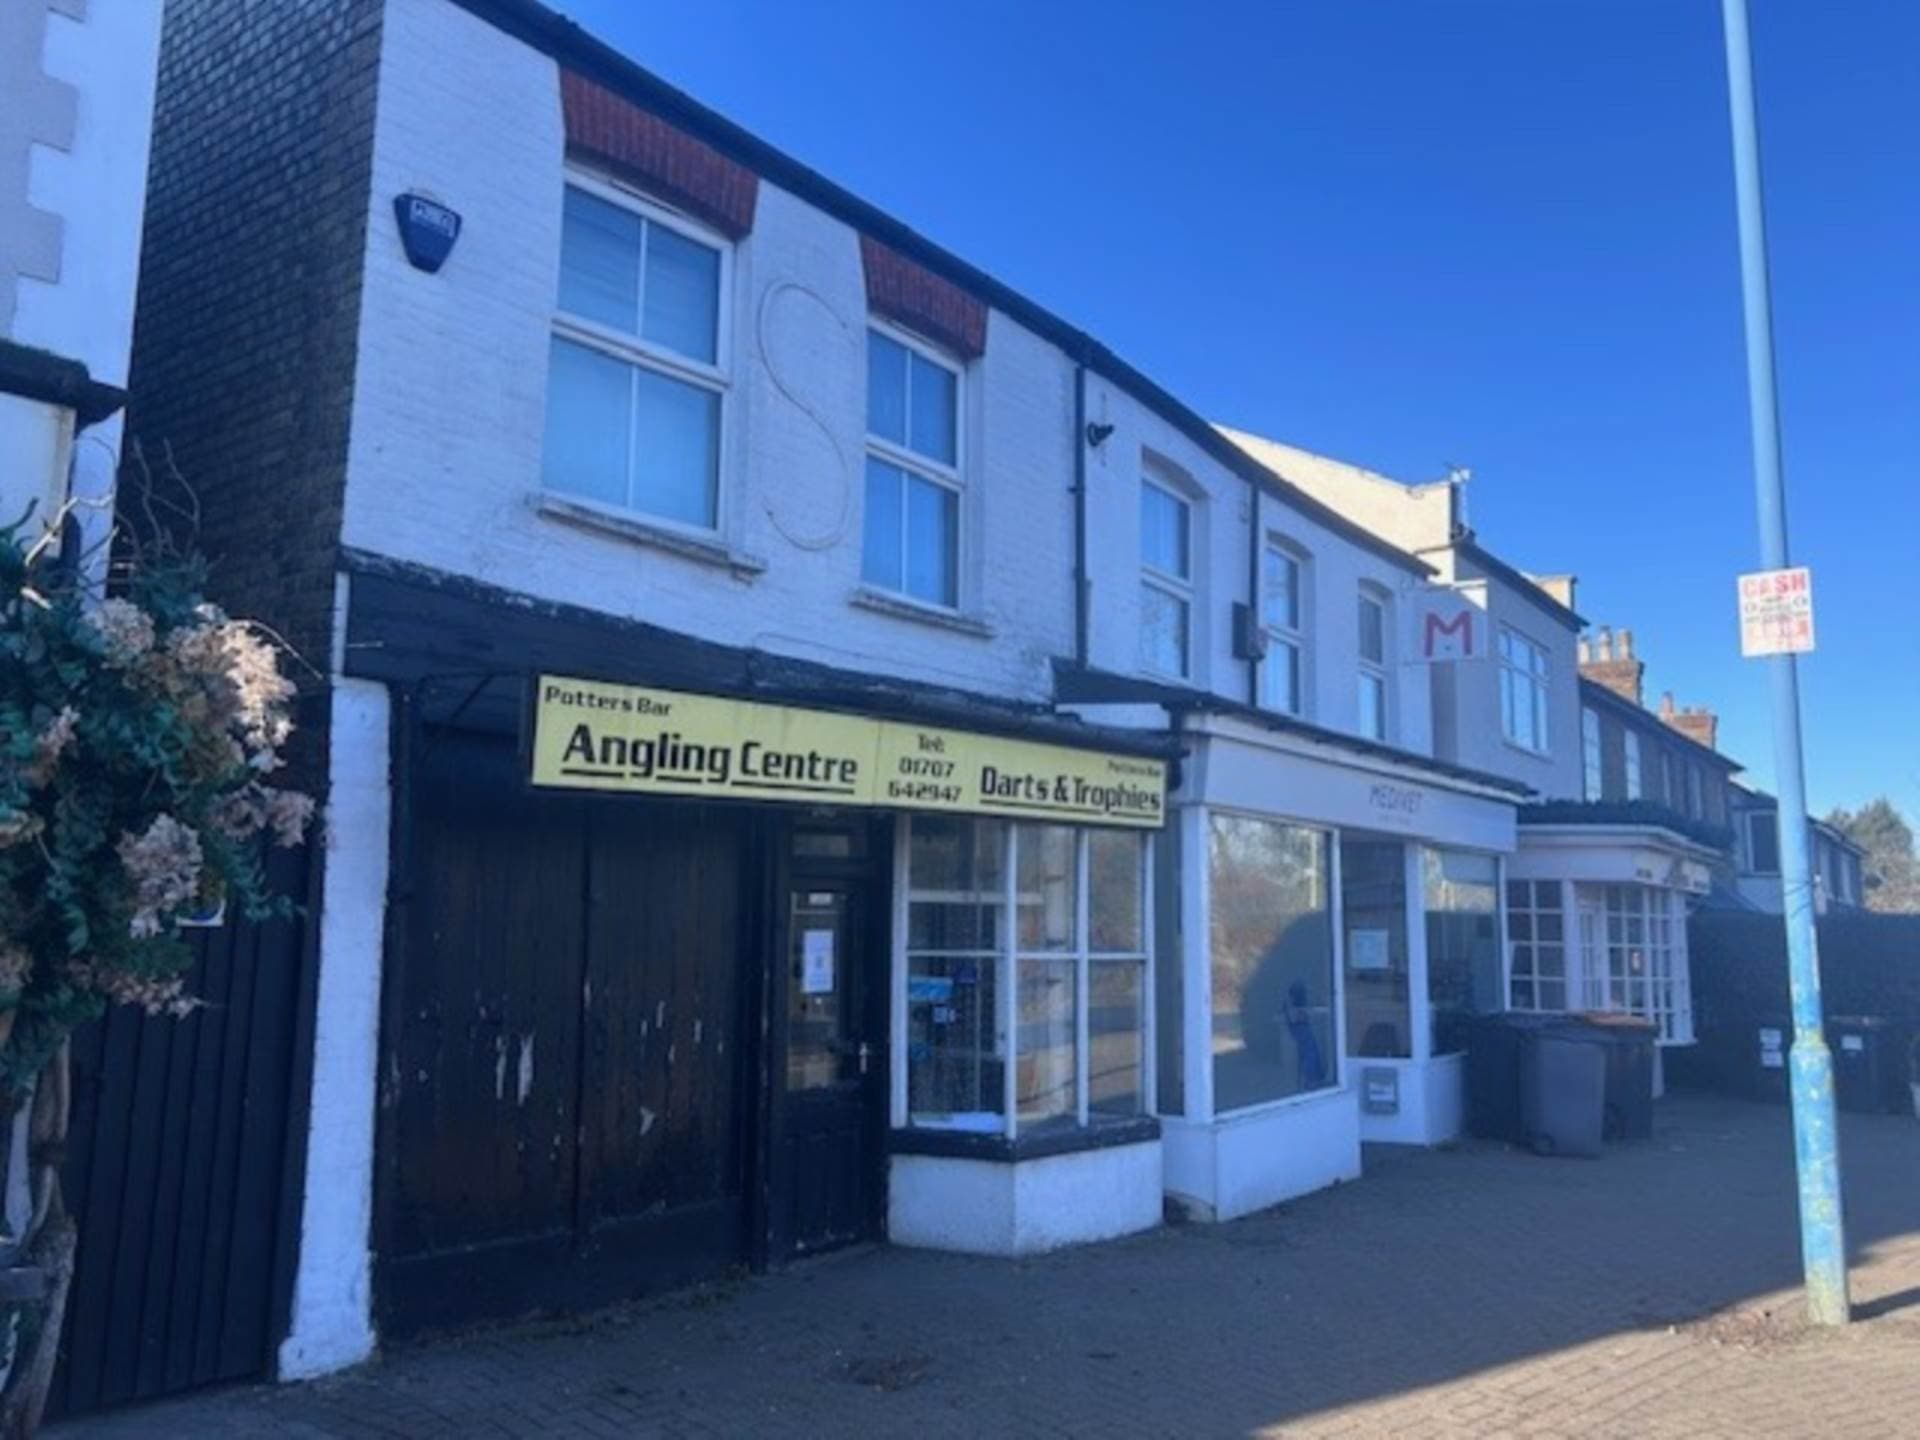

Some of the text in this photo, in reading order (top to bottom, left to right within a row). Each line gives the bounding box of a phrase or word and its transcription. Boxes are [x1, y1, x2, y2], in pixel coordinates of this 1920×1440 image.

[1424, 610, 1472, 657] M
[545, 685, 672, 717] Potters Bar
[562, 722, 858, 784] Angling Centre
[898, 756, 955, 779] 01707
[888, 780, 962, 803] 642947
[980, 765, 1161, 812] Darts & Trophies
